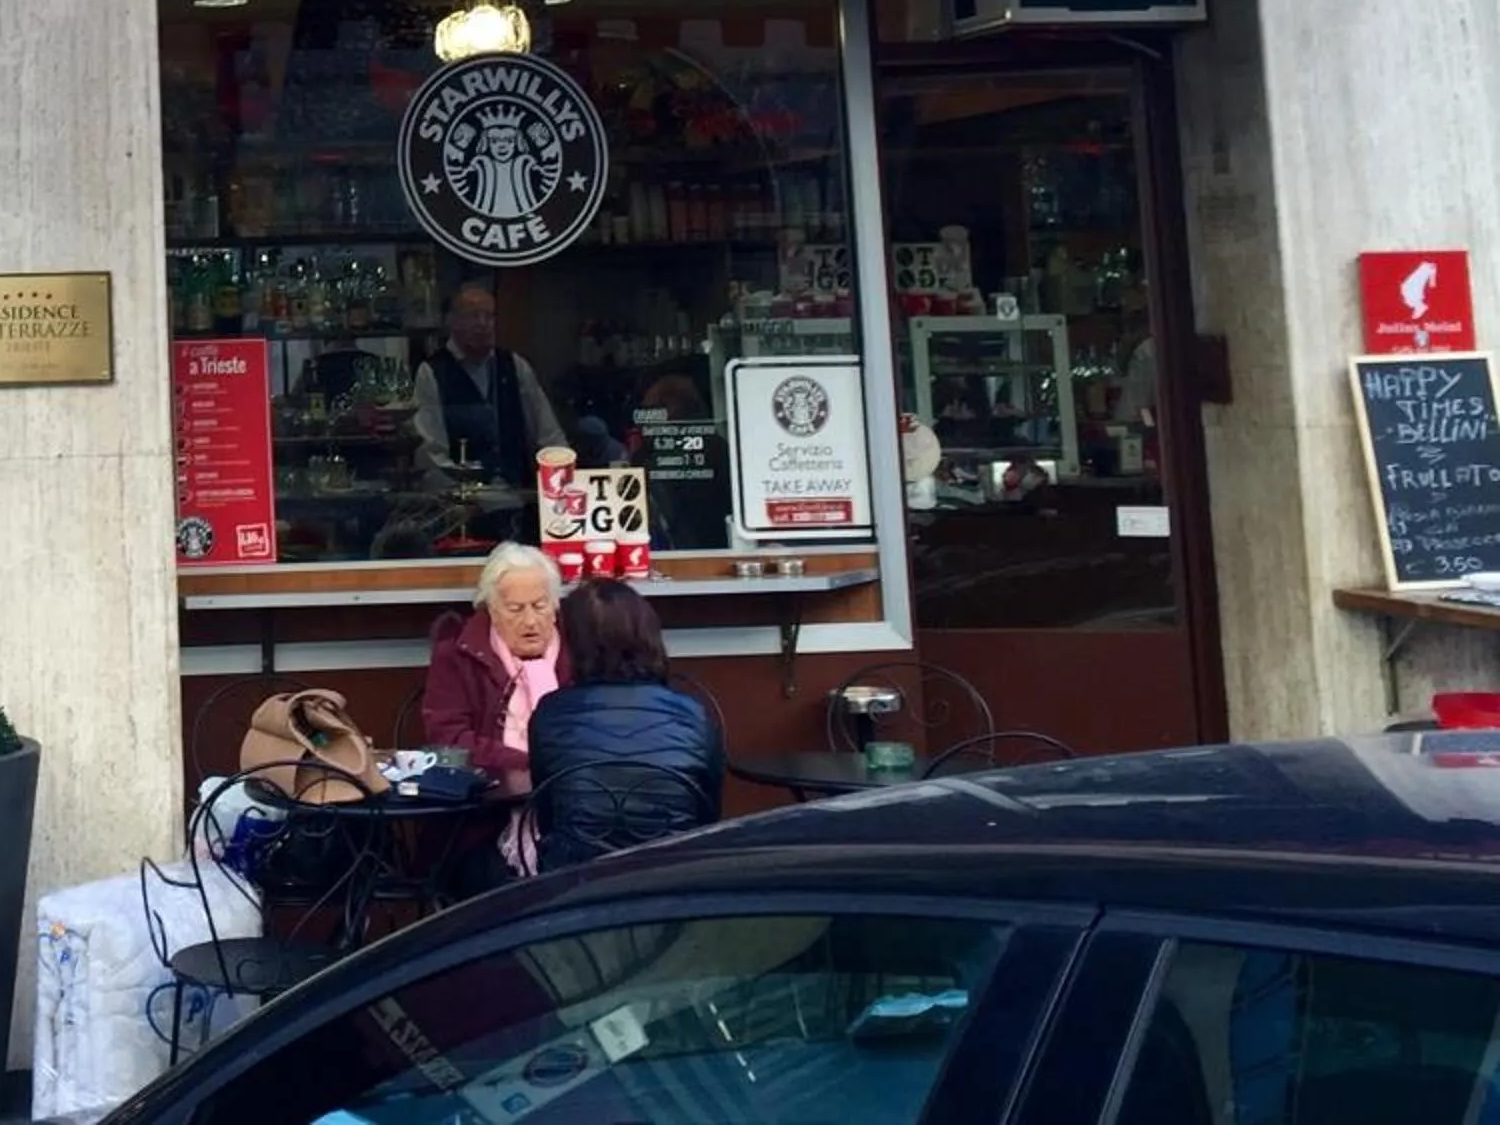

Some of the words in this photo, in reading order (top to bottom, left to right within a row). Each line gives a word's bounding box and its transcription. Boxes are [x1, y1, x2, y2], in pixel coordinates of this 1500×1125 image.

[419, 65, 585, 144] STARWILLYS
[189, 361, 198, 375] a
[201, 357, 247, 375] Trieste
[1365, 366, 1462, 400] HAPPY
[776, 442, 833, 457] Servizio
[768, 457, 844, 473] Caffetteria
[589, 474, 641, 501] TO
[761, 480, 802, 494] TAKE
[805, 479, 852, 492] AWAY
[591, 504, 643, 533] GO
